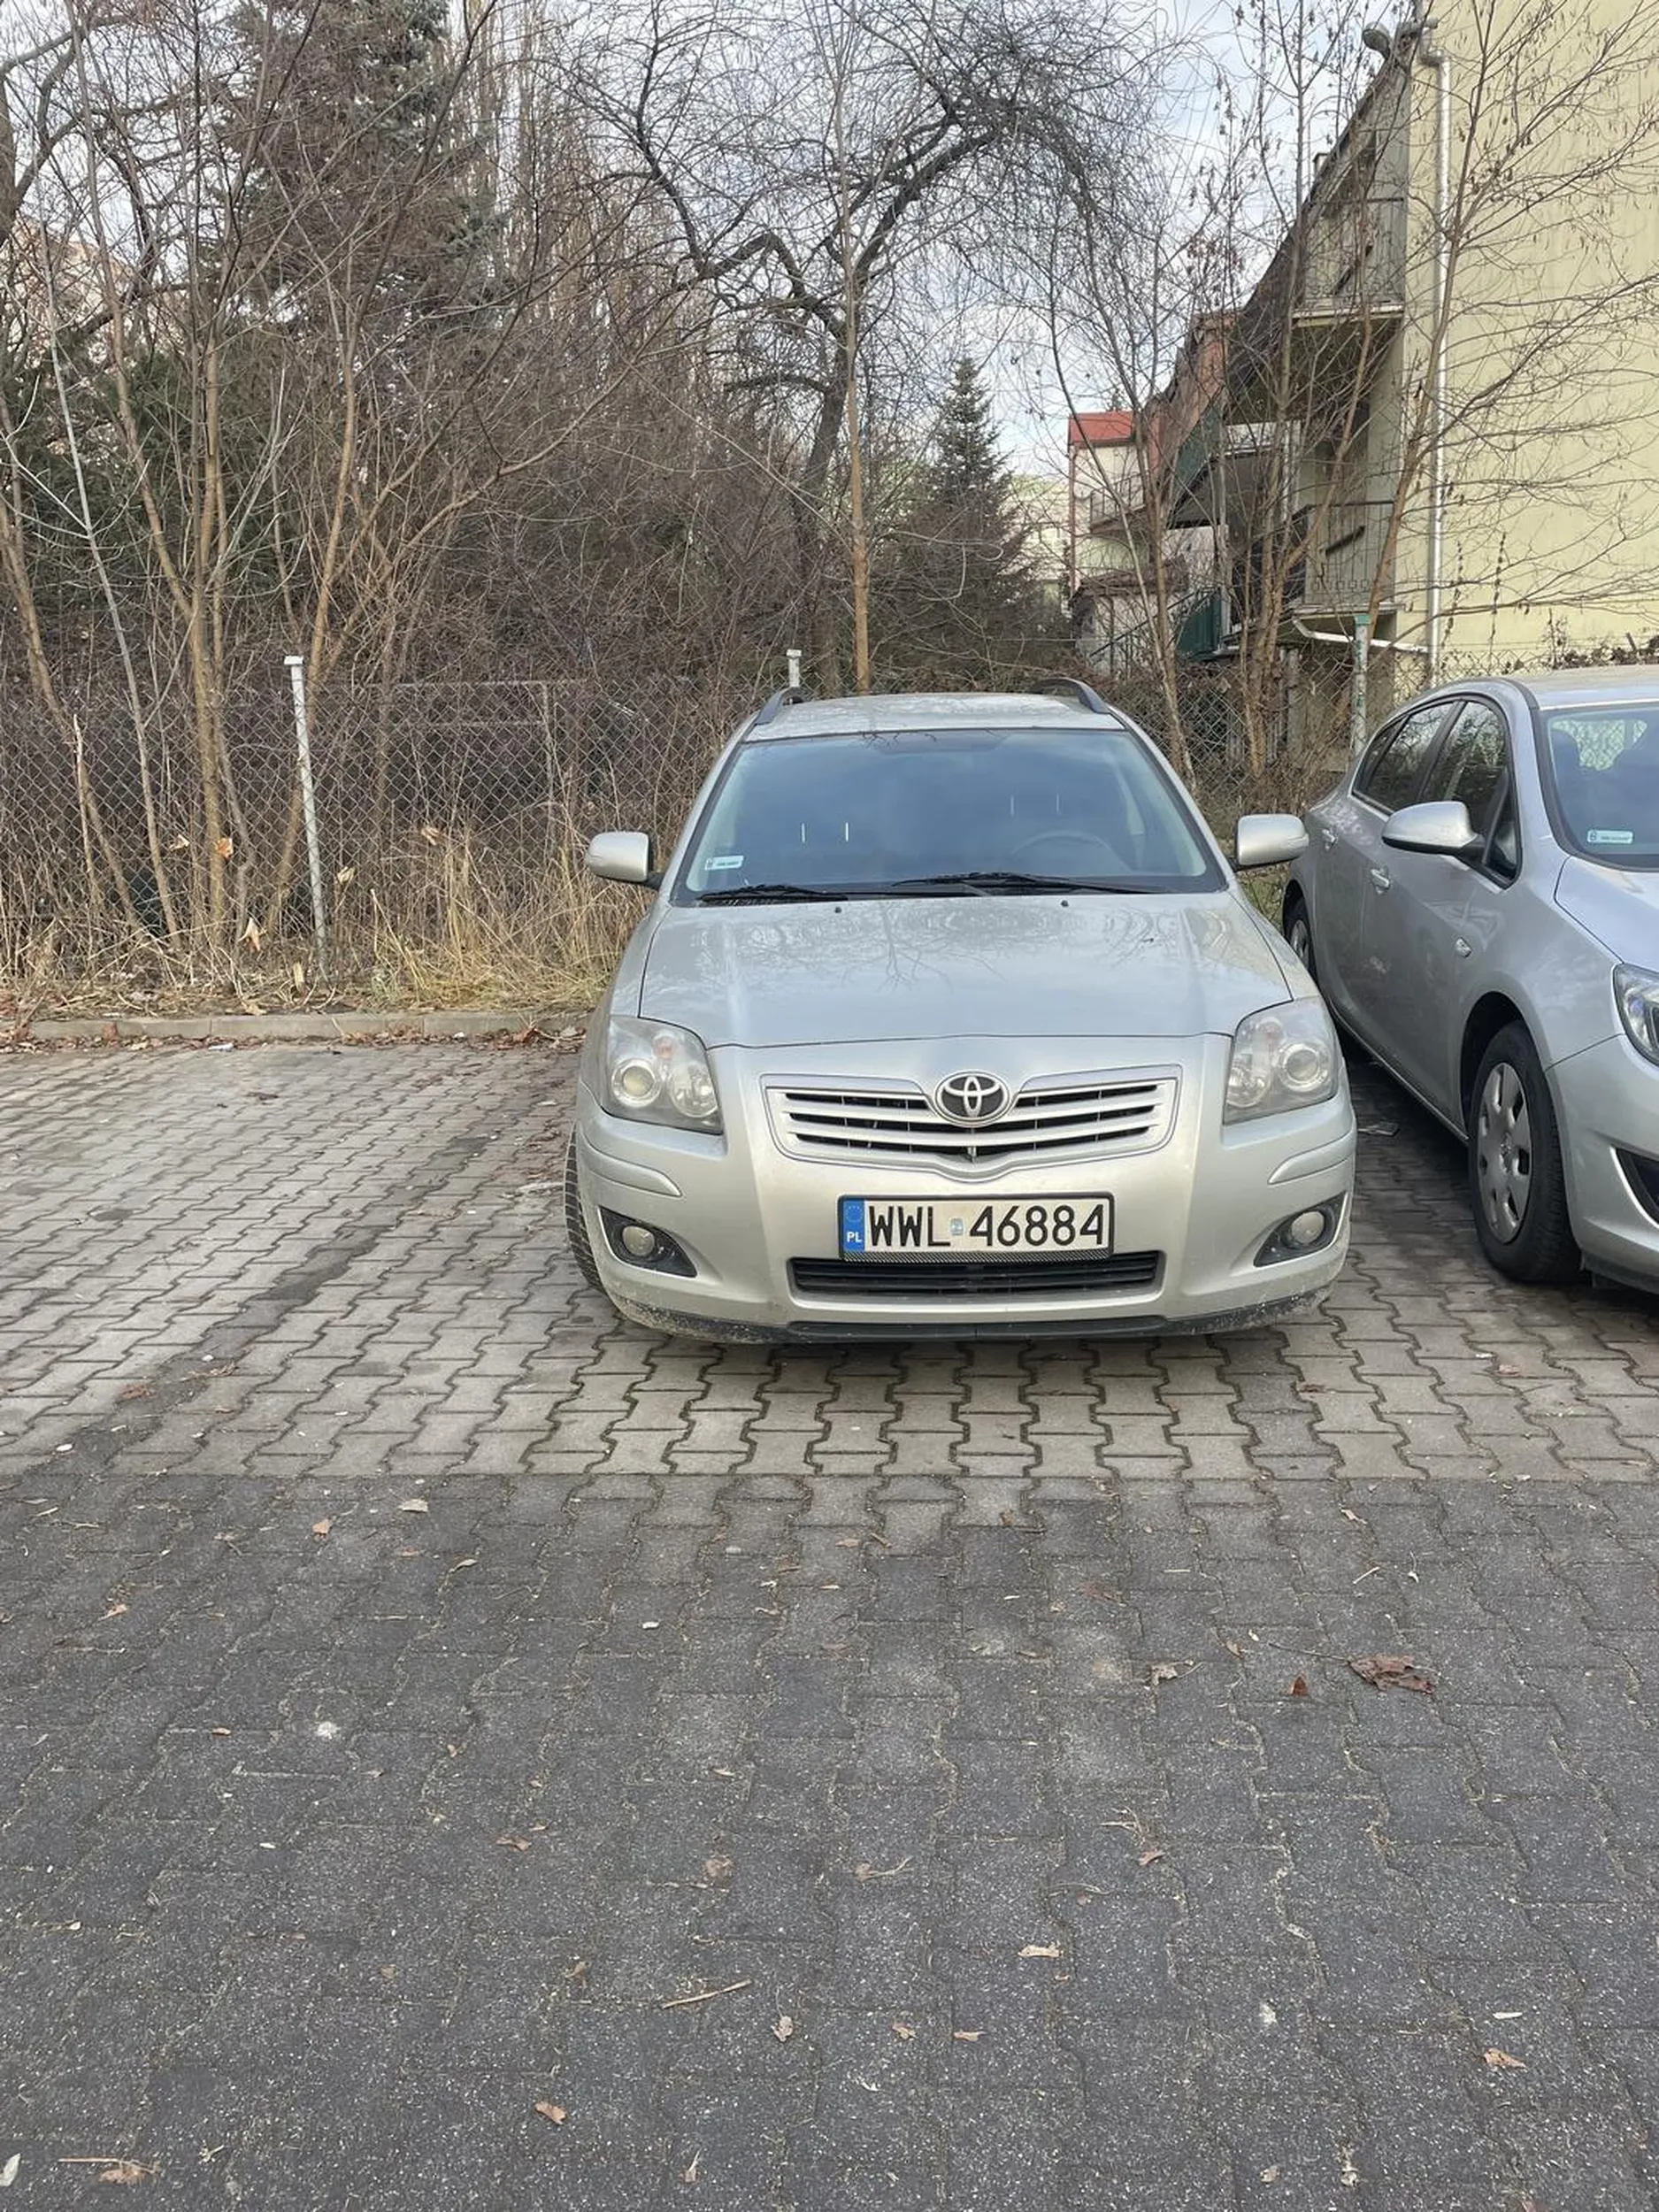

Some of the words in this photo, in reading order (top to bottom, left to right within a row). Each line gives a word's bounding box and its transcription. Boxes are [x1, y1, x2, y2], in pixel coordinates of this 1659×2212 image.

[847, 1232, 863, 1243] PL
[868, 1205, 951, 1247] WWL
[969, 1203, 1104, 1247] 46884
